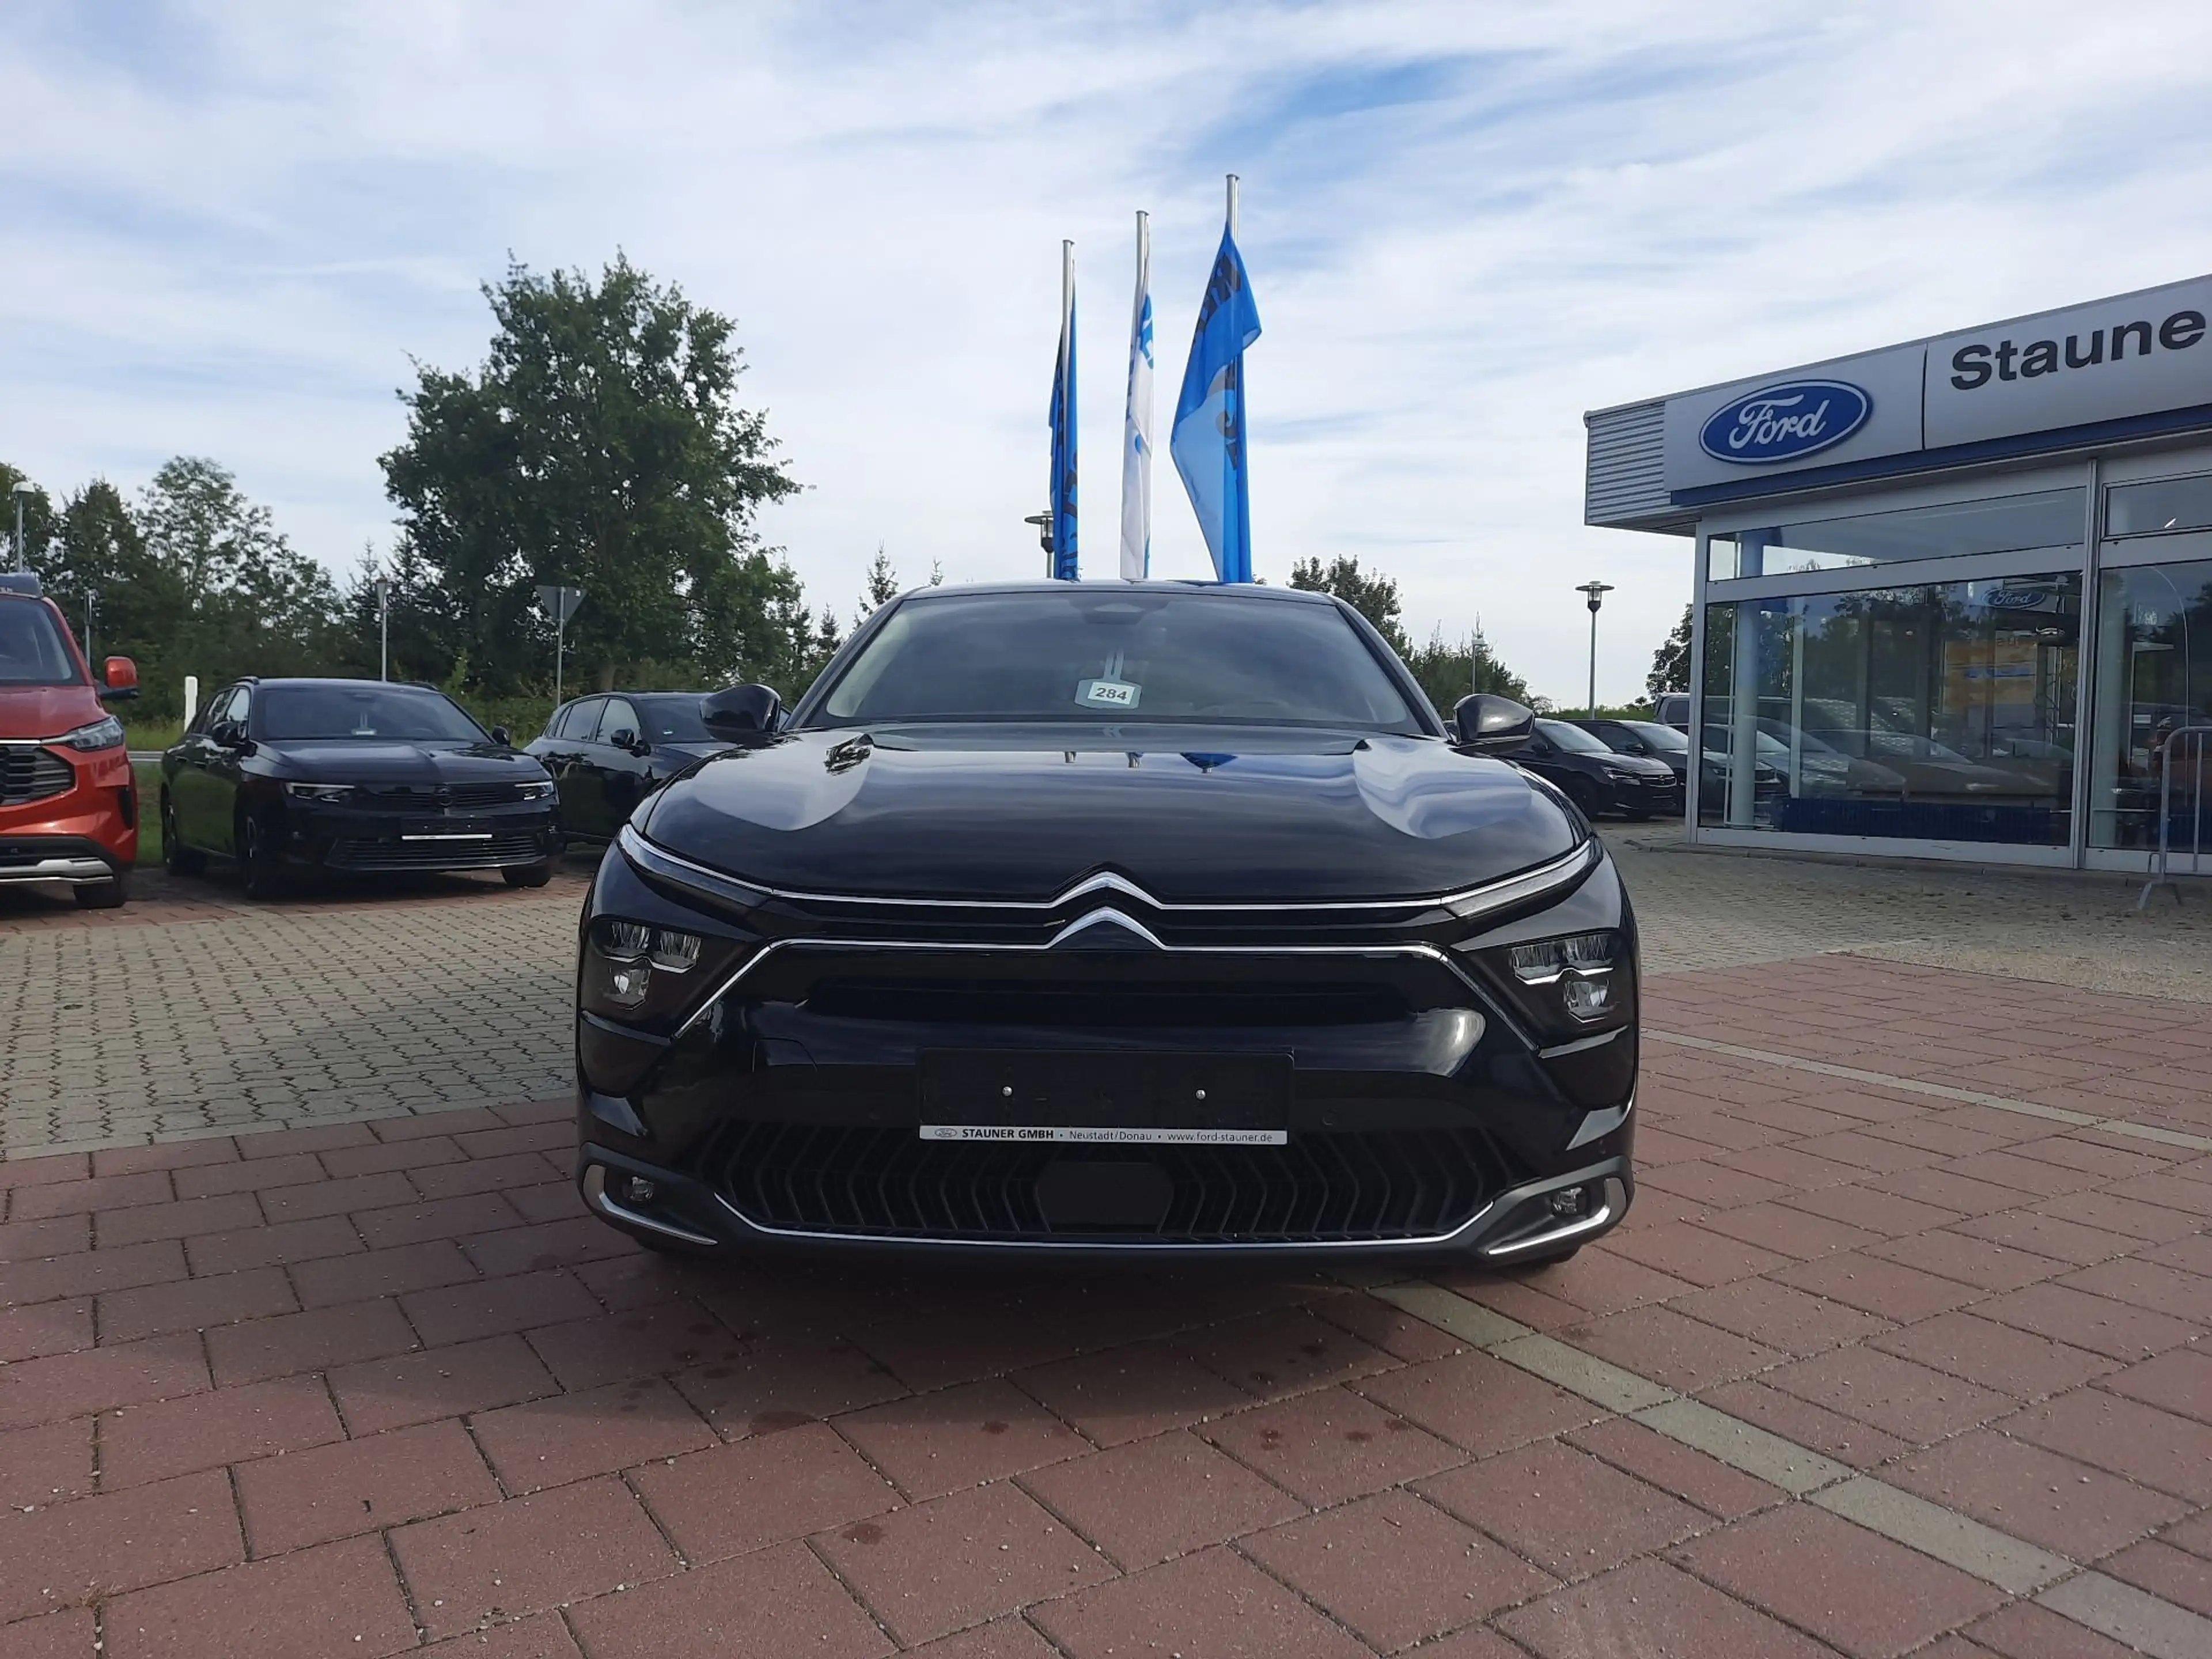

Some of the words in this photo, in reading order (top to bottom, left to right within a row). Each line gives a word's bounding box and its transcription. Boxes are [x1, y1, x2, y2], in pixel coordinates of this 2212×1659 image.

[1950, 310, 2206, 391] Staune
[1729, 394, 1831, 449] Ford
[1994, 589, 2032, 605] Ford
[1095, 687, 1127, 700] 284
[962, 1128, 1014, 1138] STAUNER
[1018, 1129, 1054, 1139] GMBH
[1069, 1130, 1152, 1141] Neustadt/Donau
[1167, 1131, 1273, 1143] www.ford-stauner.de
